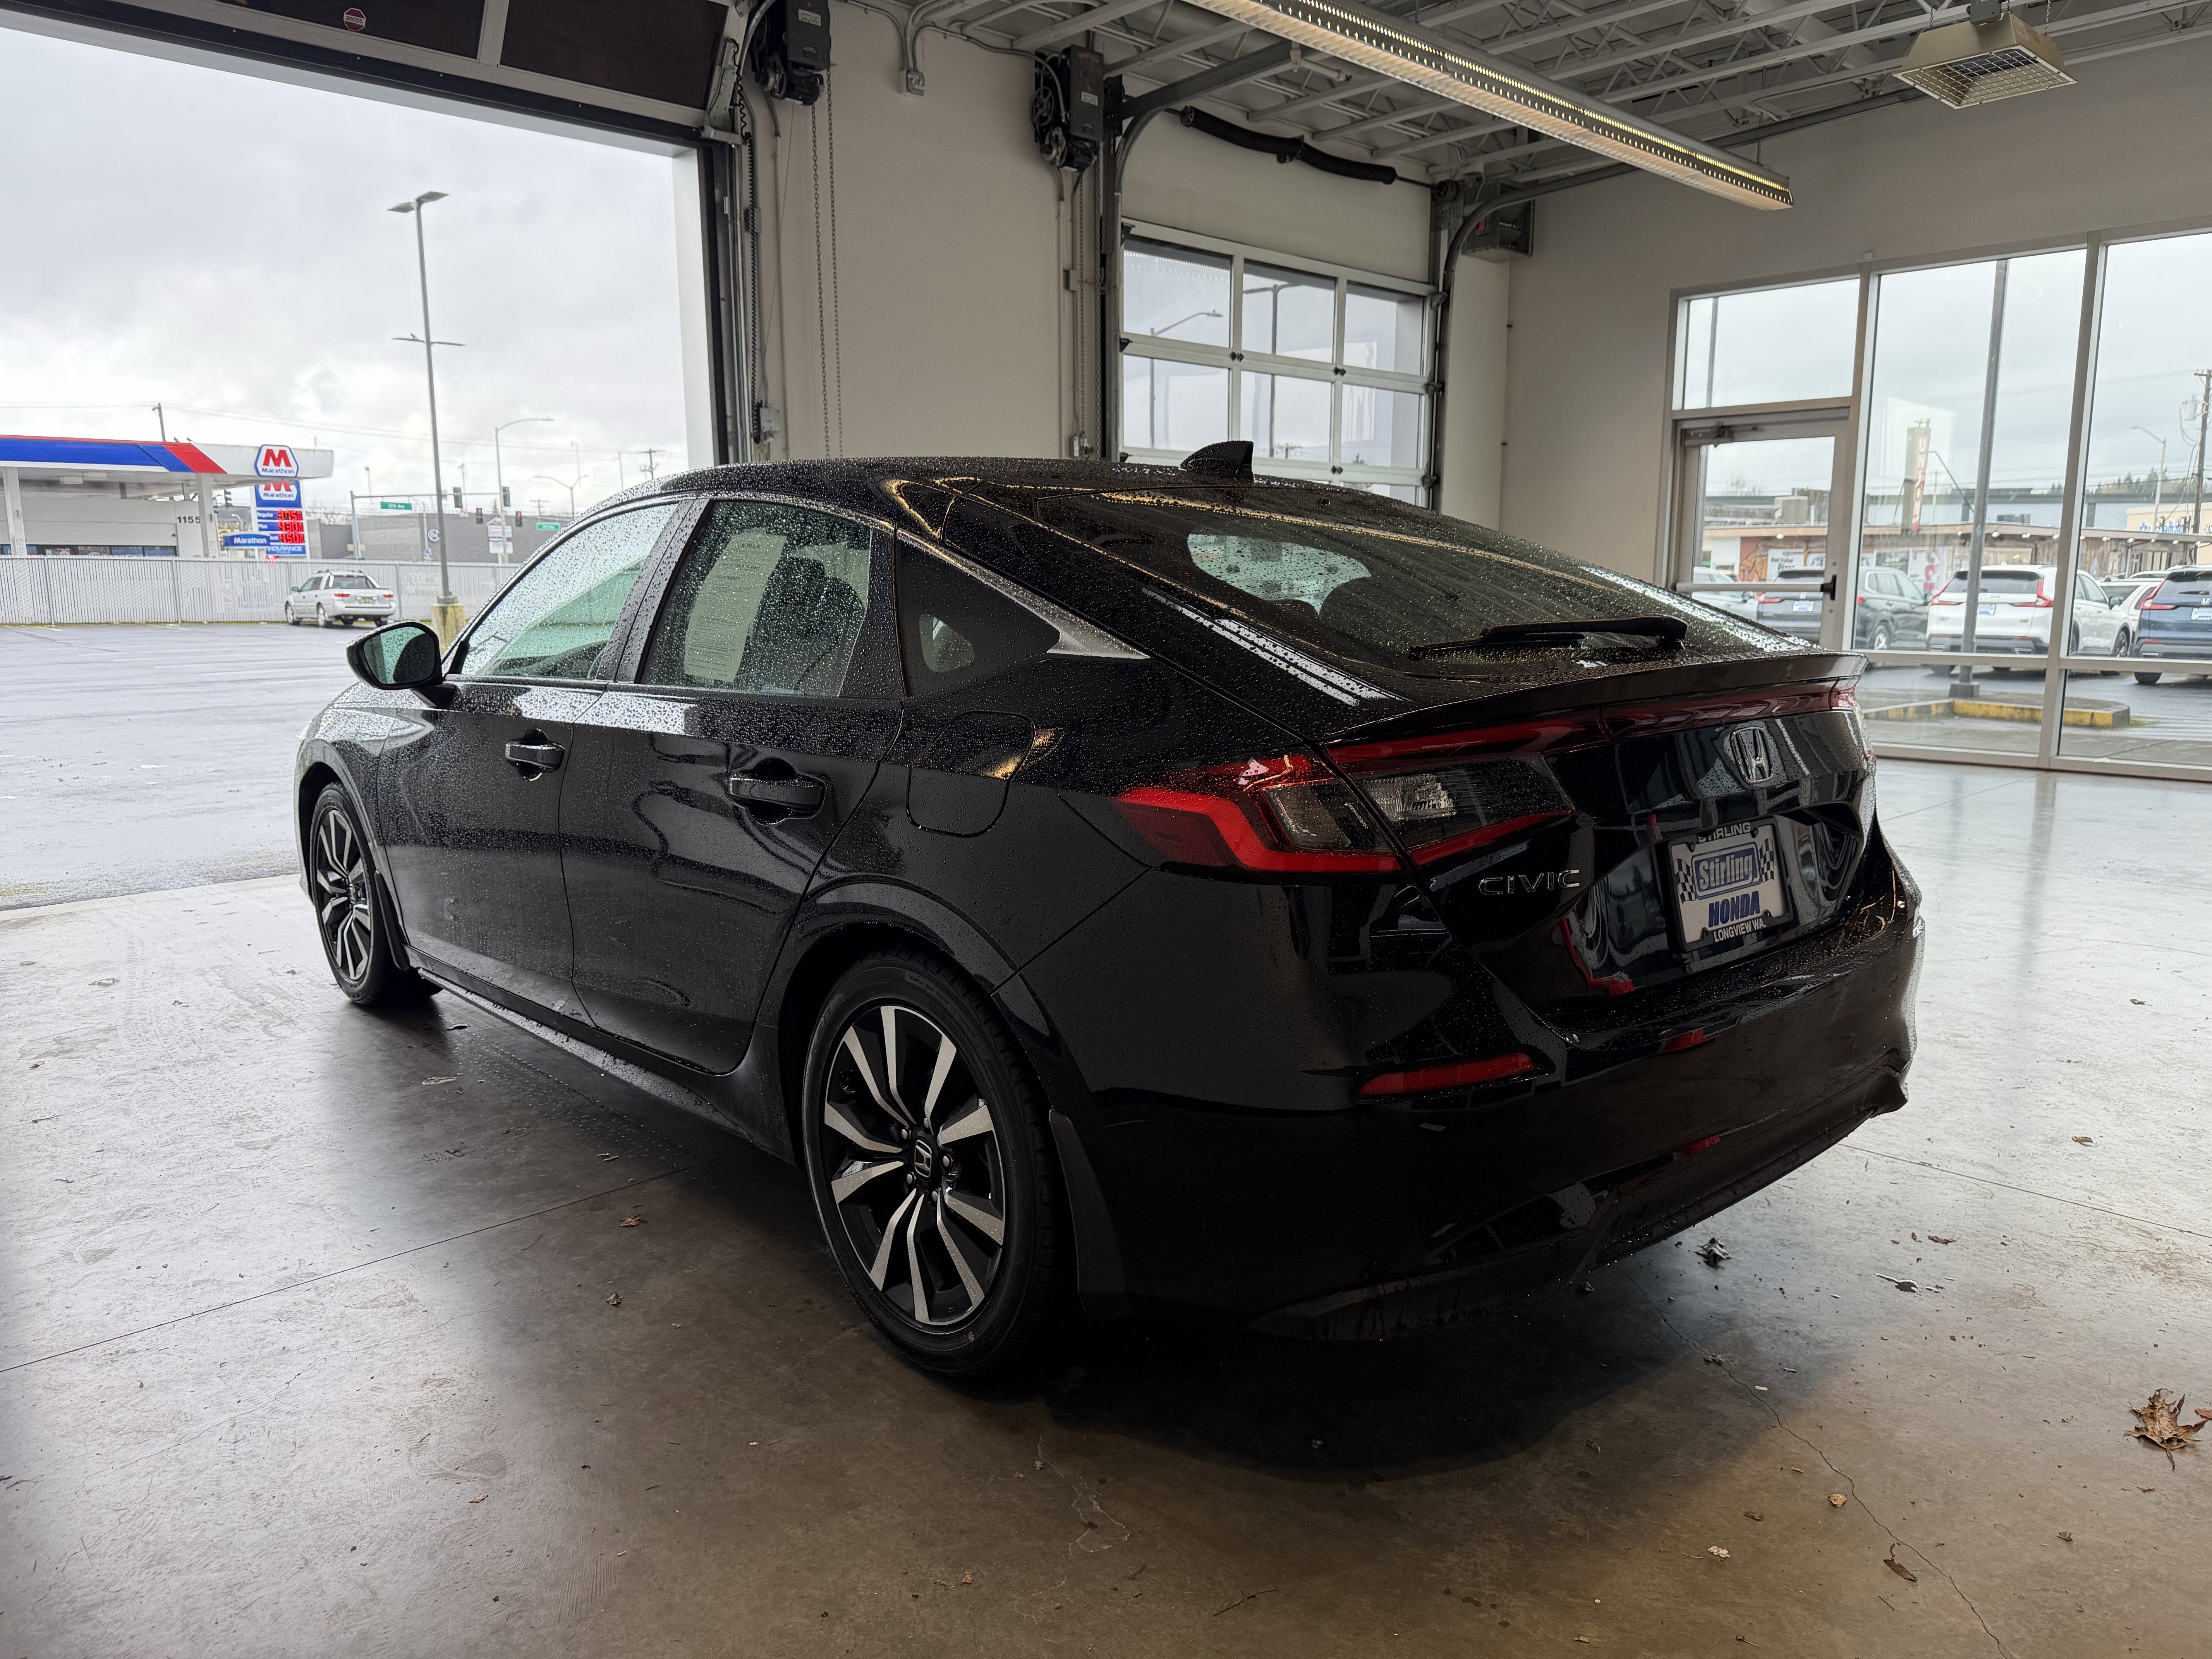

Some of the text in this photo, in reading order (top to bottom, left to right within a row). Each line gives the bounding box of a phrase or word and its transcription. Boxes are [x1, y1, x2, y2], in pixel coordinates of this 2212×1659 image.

[1479, 869, 1580, 895] CIVIC
[1699, 854, 1752, 890] Stirling
[1709, 891, 1760, 927] HONDA
[1714, 918, 1766, 942] LONGVIEW WA.
